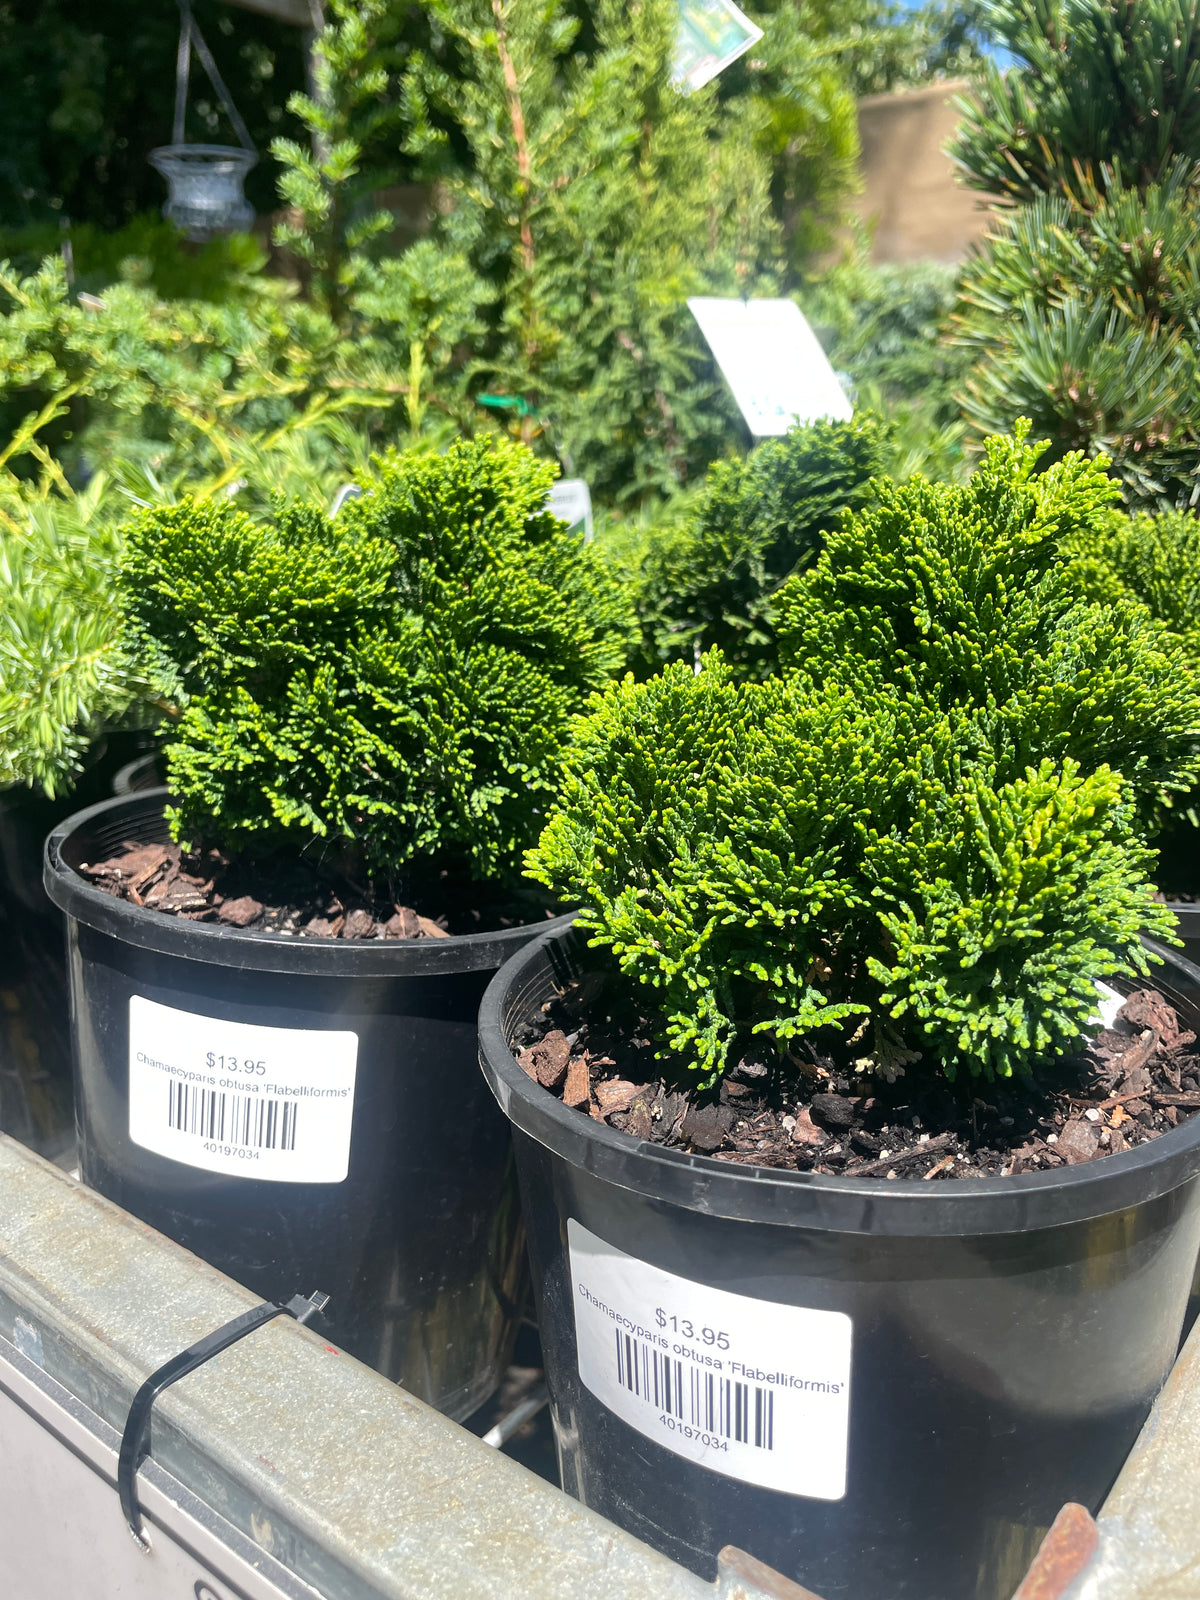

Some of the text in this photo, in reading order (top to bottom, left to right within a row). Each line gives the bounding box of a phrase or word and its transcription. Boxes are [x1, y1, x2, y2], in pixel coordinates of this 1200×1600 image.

[136, 1052, 216, 1085] Chamaecyparis
[219, 1077, 259, 1093] obtusa
[206, 1051, 266, 1076] $13.95
[203, 1142, 260, 1160] 40197034
[578, 1283, 844, 1394] Chamaecyparis obtusa 'Flabelliformis'
[655, 1307, 730, 1350] $13.95
[659, 1414, 729, 1452] 40197034
